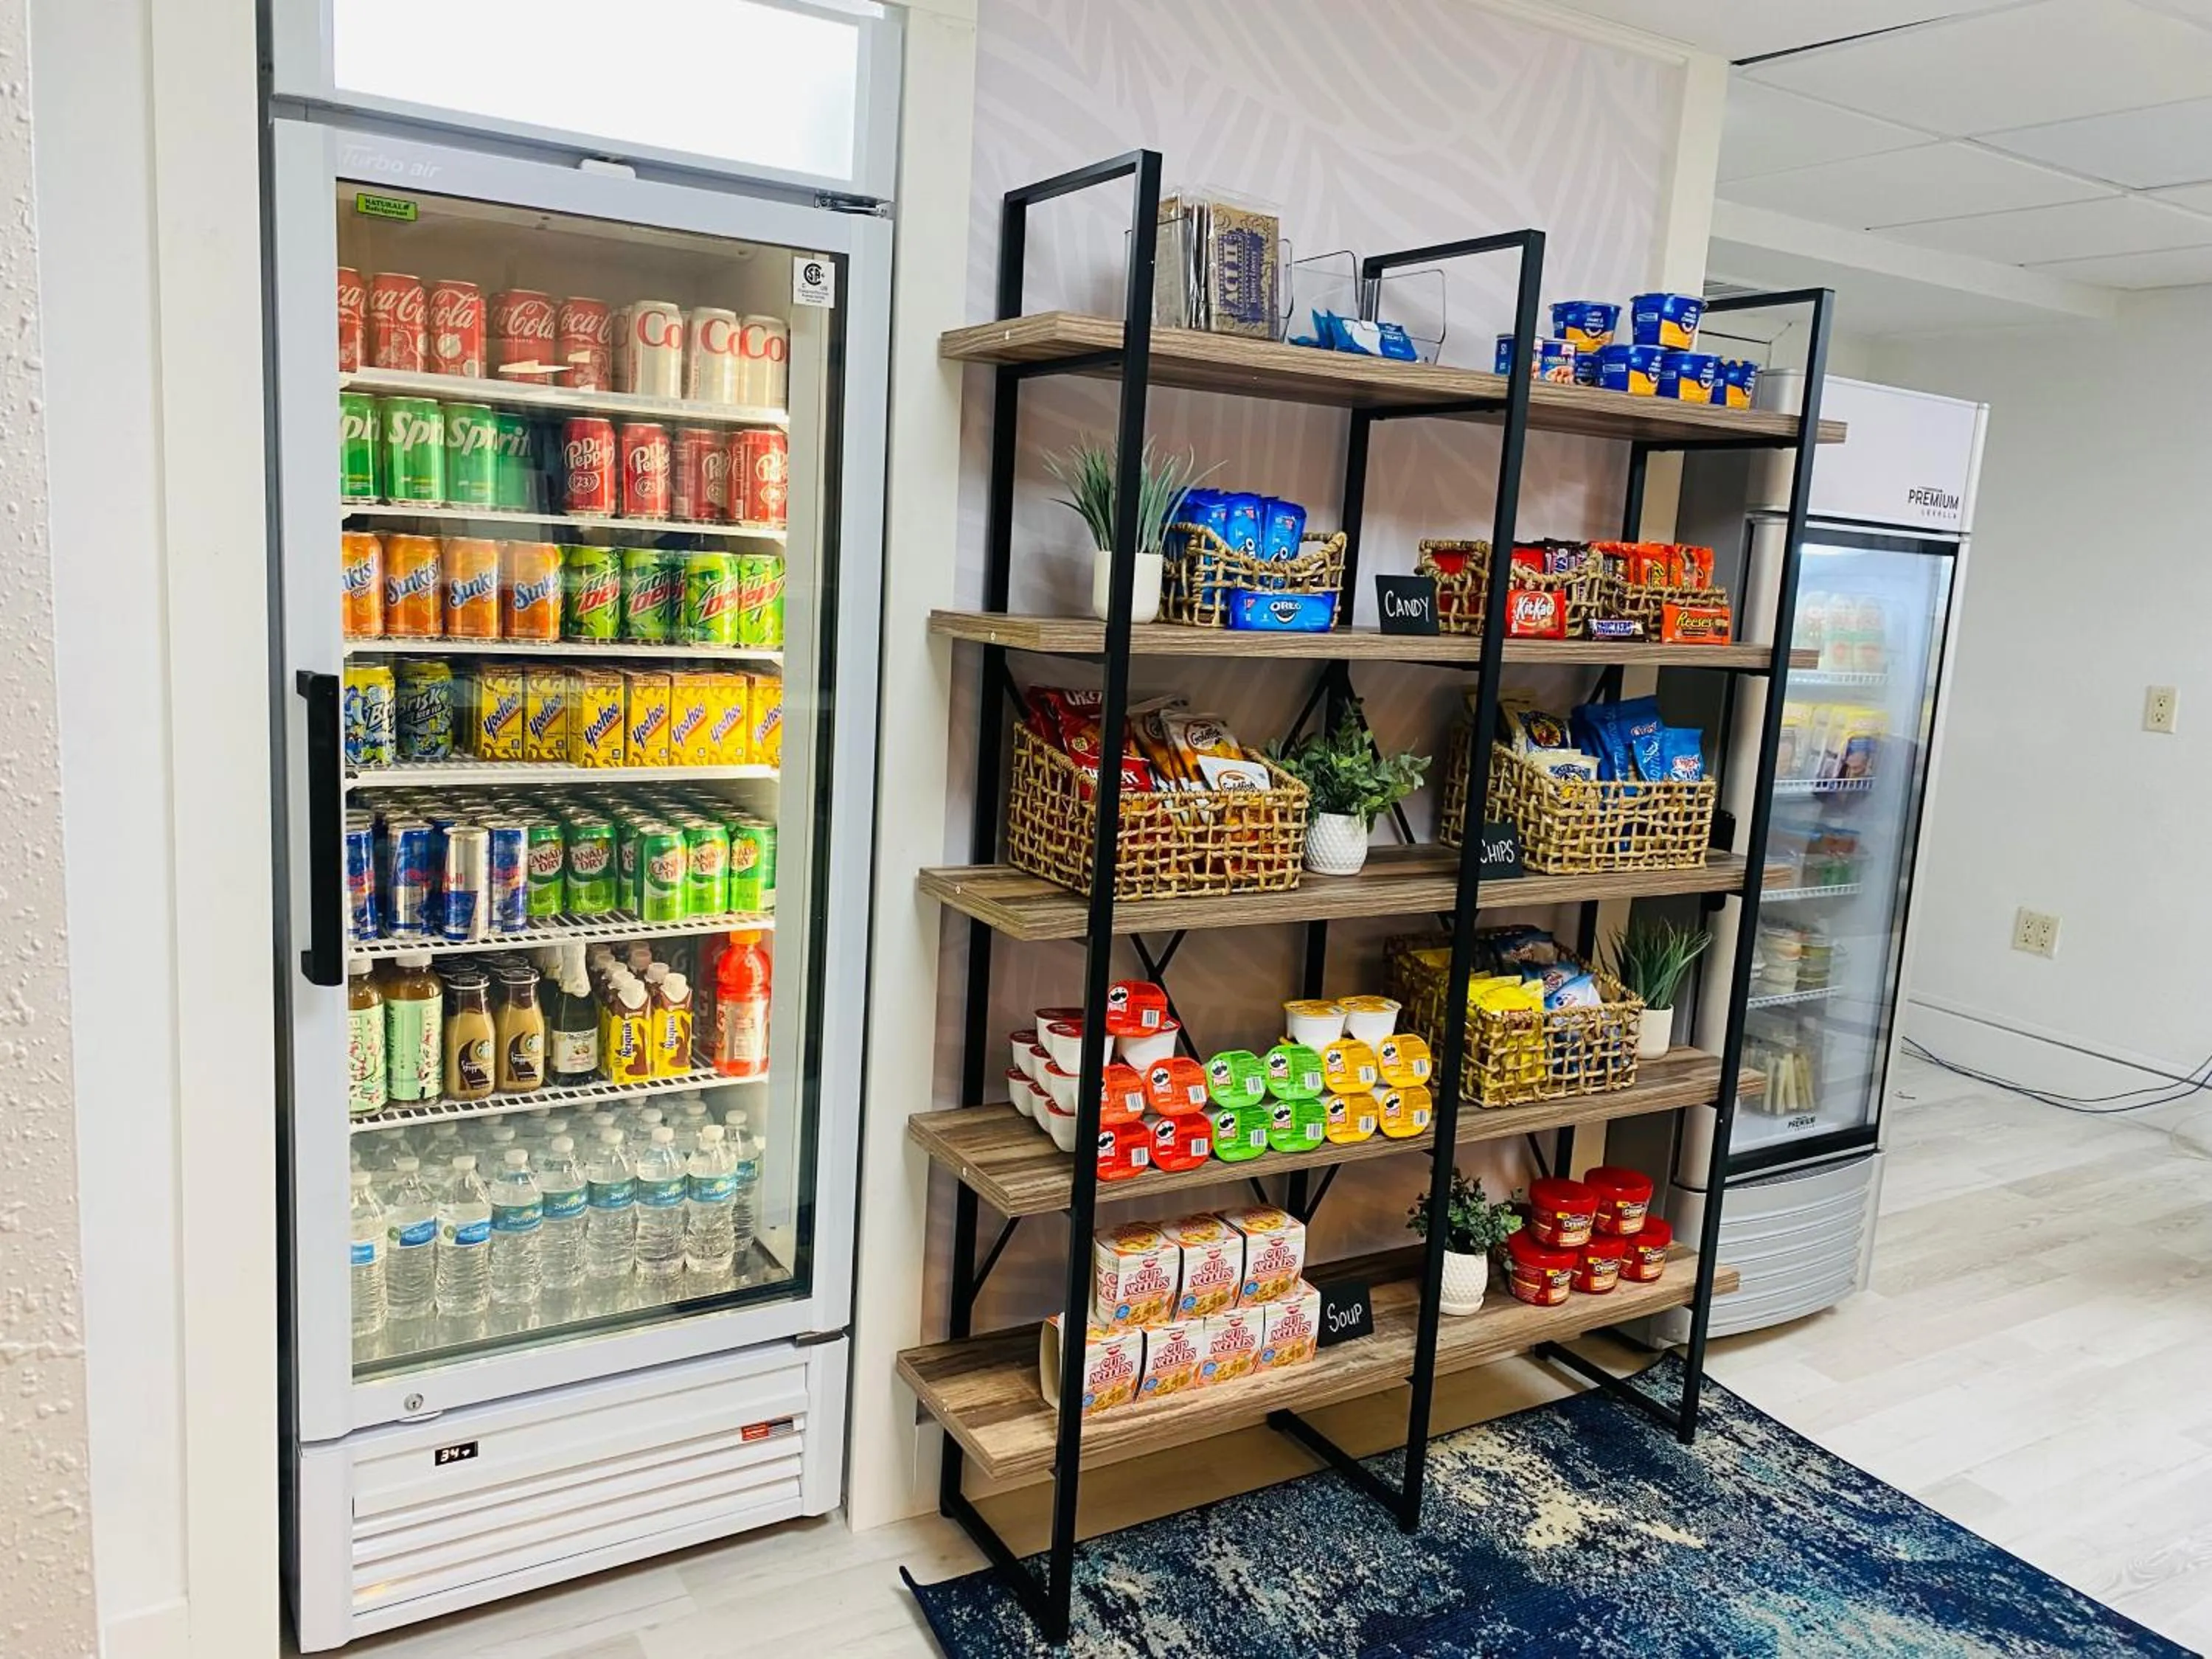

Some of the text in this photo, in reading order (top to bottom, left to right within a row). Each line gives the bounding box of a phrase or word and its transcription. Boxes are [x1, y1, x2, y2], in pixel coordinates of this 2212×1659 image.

[410, 160, 442, 178] air
[1223, 268, 1238, 305] ACT
[1907, 488, 1959, 510] PREMIUM
[387, 555, 441, 606] Sunkist
[1270, 601, 1302, 611] OREO
[1384, 591, 1430, 621] CANDY
[1191, 727, 1225, 745] Goldfish
[539, 857, 560, 872] DRY
[580, 856, 604, 871] DRY
[1263, 1245, 1290, 1262] CUP
[1201, 1258, 1226, 1275] CUP
[1253, 1254, 1297, 1275] NOODLES
[1135, 1267, 1162, 1284] CUP
[1189, 1265, 1235, 1287] NOODLES
[1123, 1276, 1171, 1297] NOODLES
[1280, 1313, 1305, 1329] CUP
[1327, 1303, 1363, 1332] SOUP
[1221, 1326, 1248, 1342] CUP
[1269, 1321, 1312, 1343] NOODLES
[1164, 1339, 1189, 1357] CUP
[1210, 1334, 1256, 1354] NOODLES
[1100, 1353, 1126, 1372] CUP
[1152, 1347, 1197, 1371] NOODLES
[1088, 1361, 1133, 1386] NOODLES
[440, 1447, 459, 1462] 34
